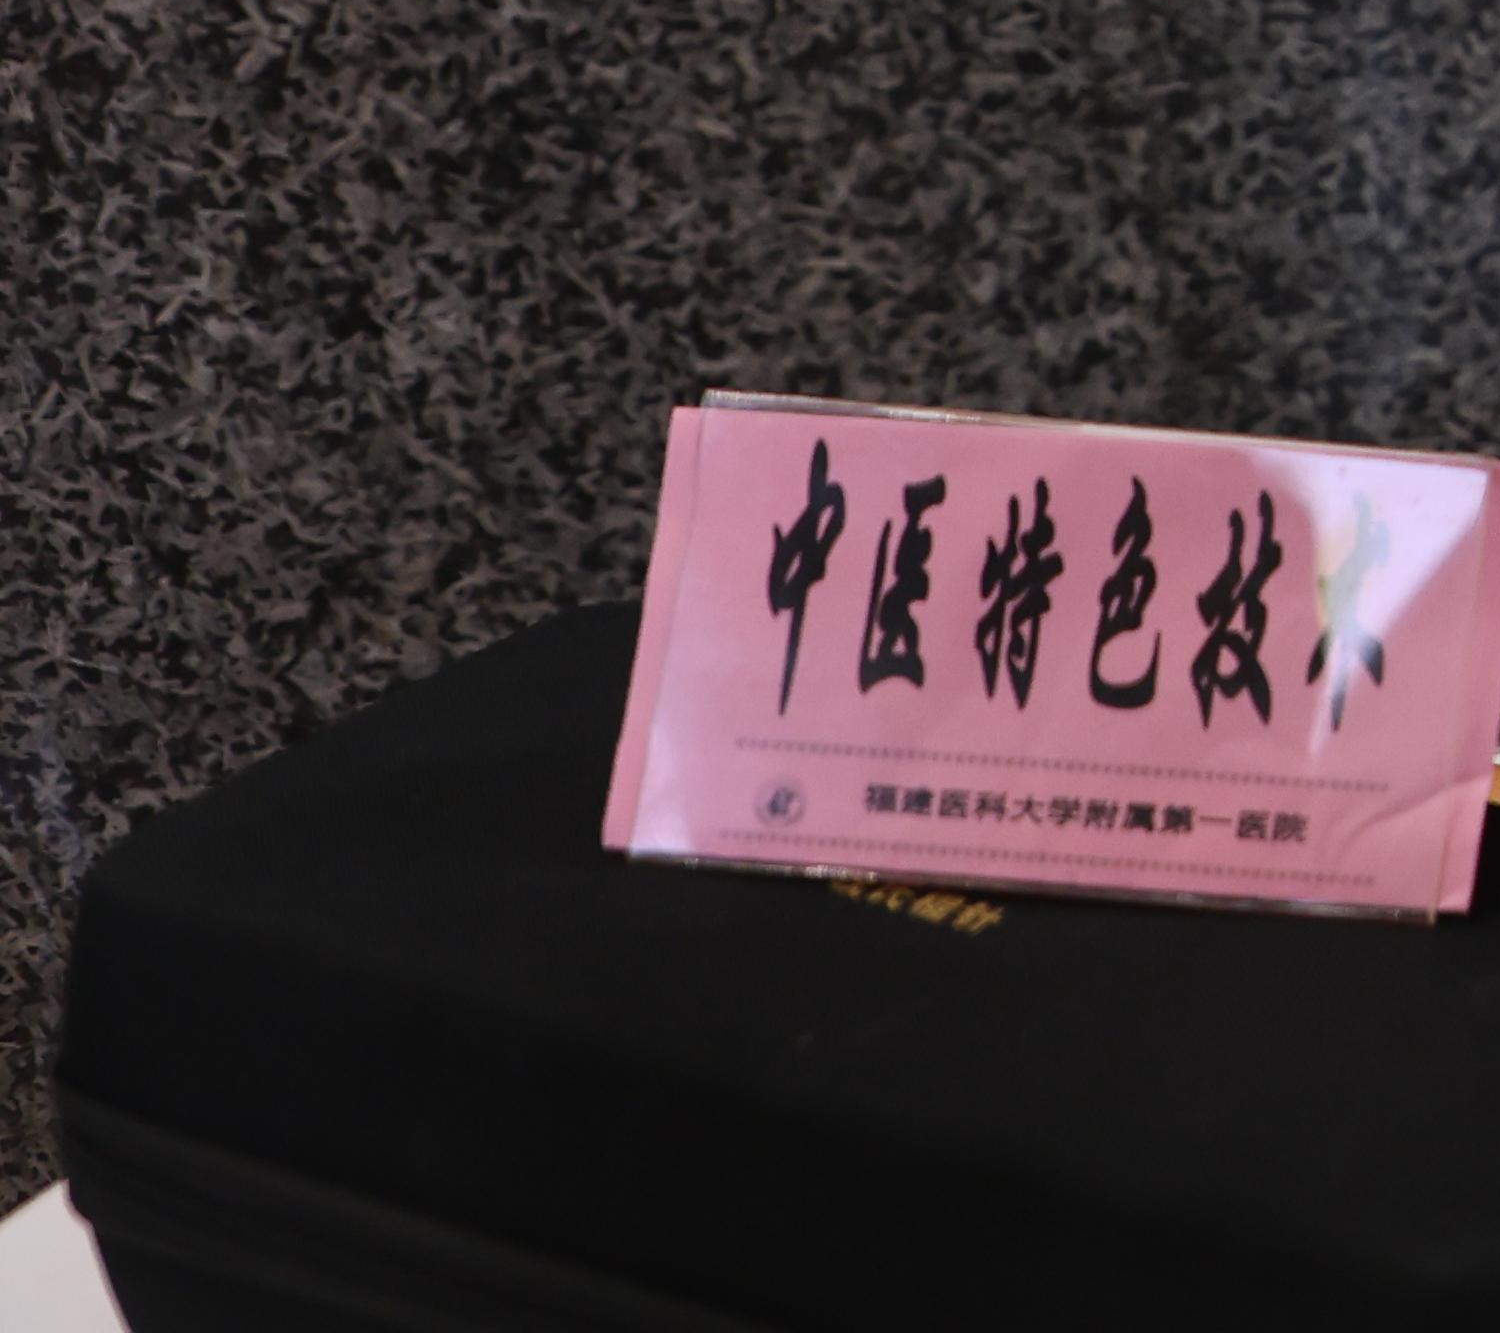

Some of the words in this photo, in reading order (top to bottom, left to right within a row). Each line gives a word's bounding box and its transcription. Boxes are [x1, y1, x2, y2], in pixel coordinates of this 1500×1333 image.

[767, 438, 1386, 731] 中医特色技术
[864, 782, 1308, 844] 福建医科大学附属第一医院
